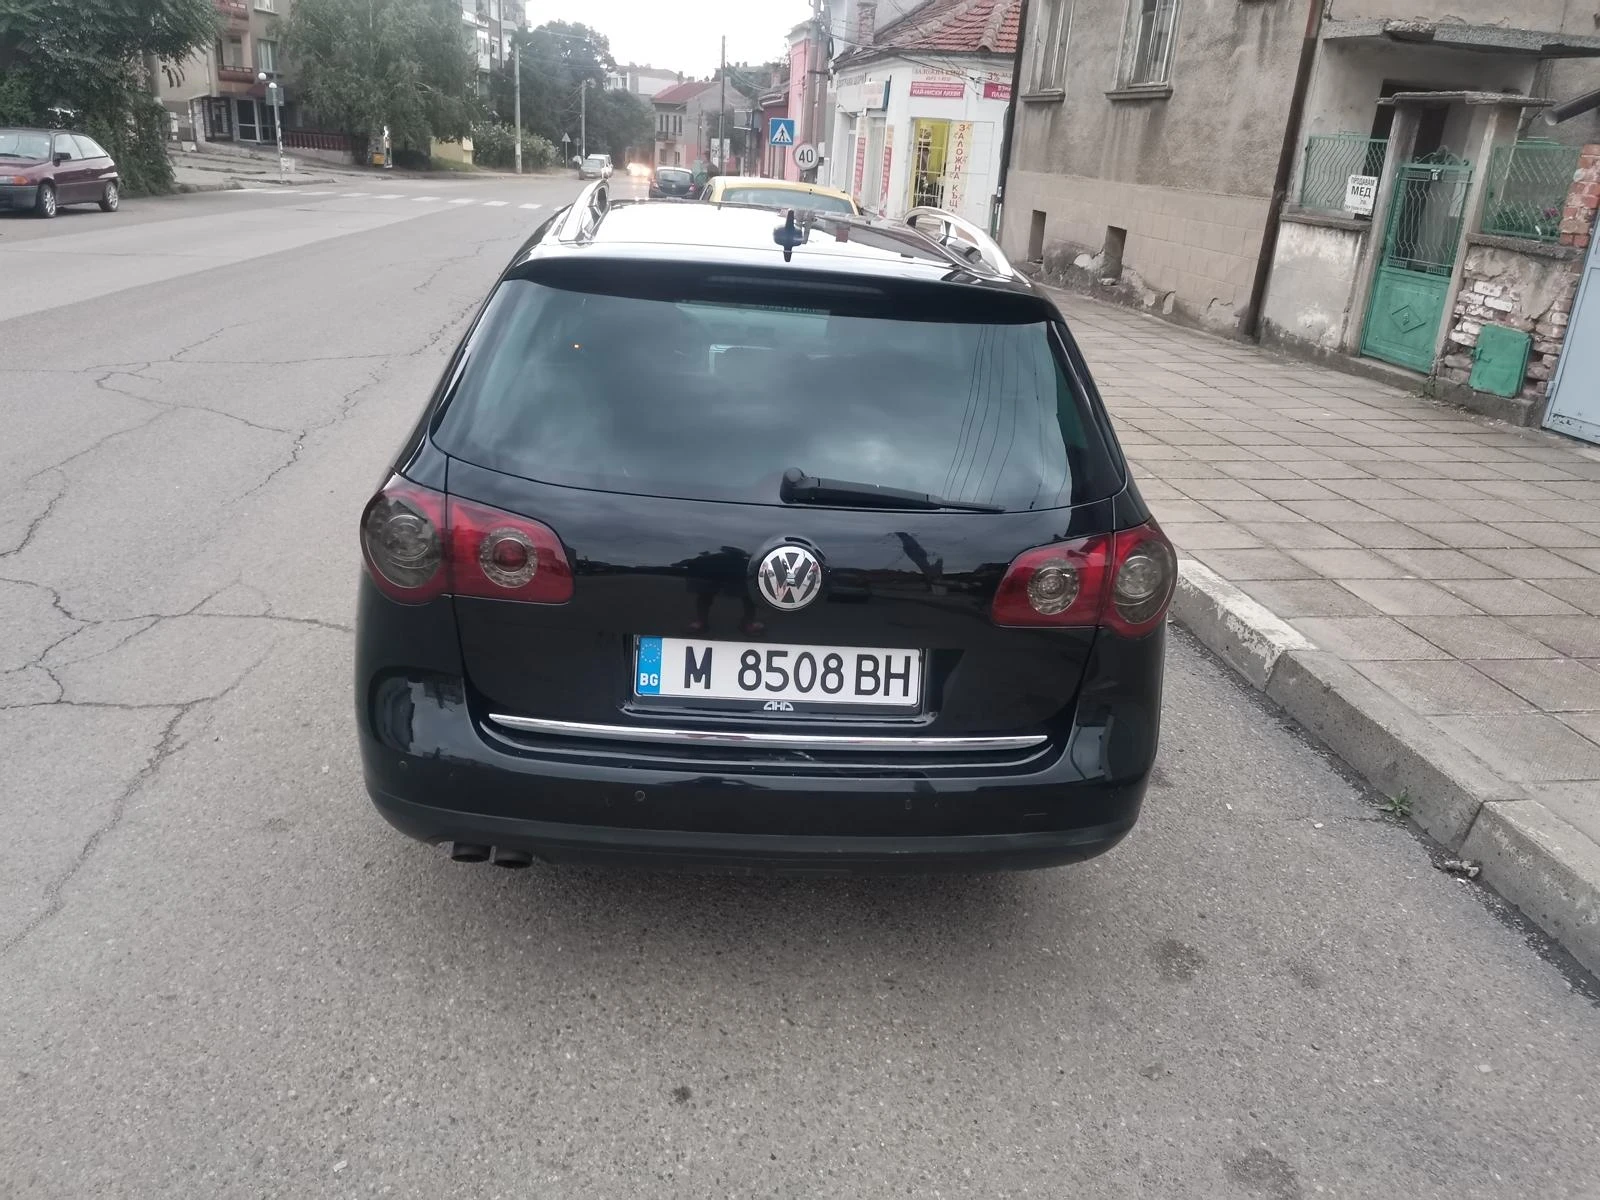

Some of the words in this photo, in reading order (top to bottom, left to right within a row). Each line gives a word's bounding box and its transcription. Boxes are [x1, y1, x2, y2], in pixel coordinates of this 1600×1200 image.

[798, 149, 814, 163] 40
[954, 124, 966, 180] ЗАЛОЖНА
[1351, 185, 1372, 200] МЕД
[684, 646, 713, 690] M
[737, 648, 844, 695] 8508
[854, 653, 912, 697] BH
[639, 672, 659, 687] BG
